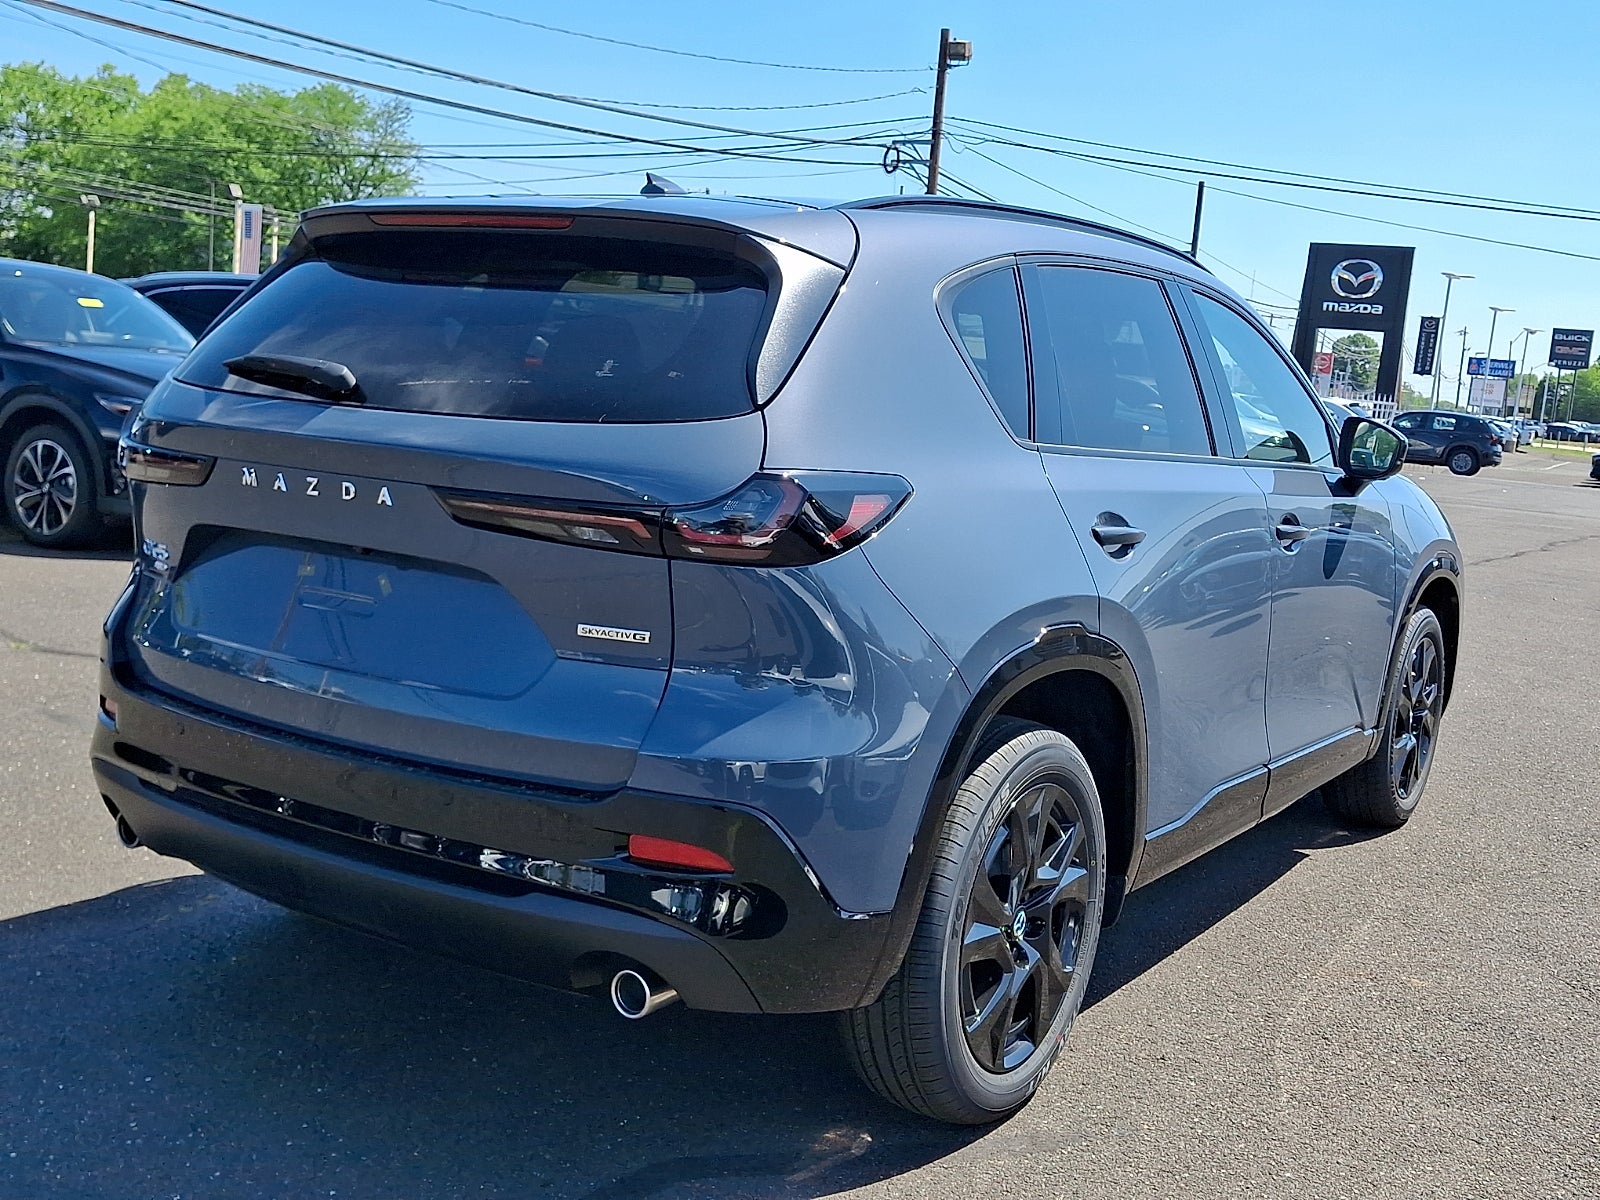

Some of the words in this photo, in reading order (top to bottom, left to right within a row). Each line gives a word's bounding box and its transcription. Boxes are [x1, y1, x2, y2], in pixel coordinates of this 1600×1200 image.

[1322, 301, 1384, 315] mazda
[1554, 333, 1590, 342] BUICK
[1480, 360, 1514, 370] SERWIN
[241, 466, 393, 507] MAZDA
